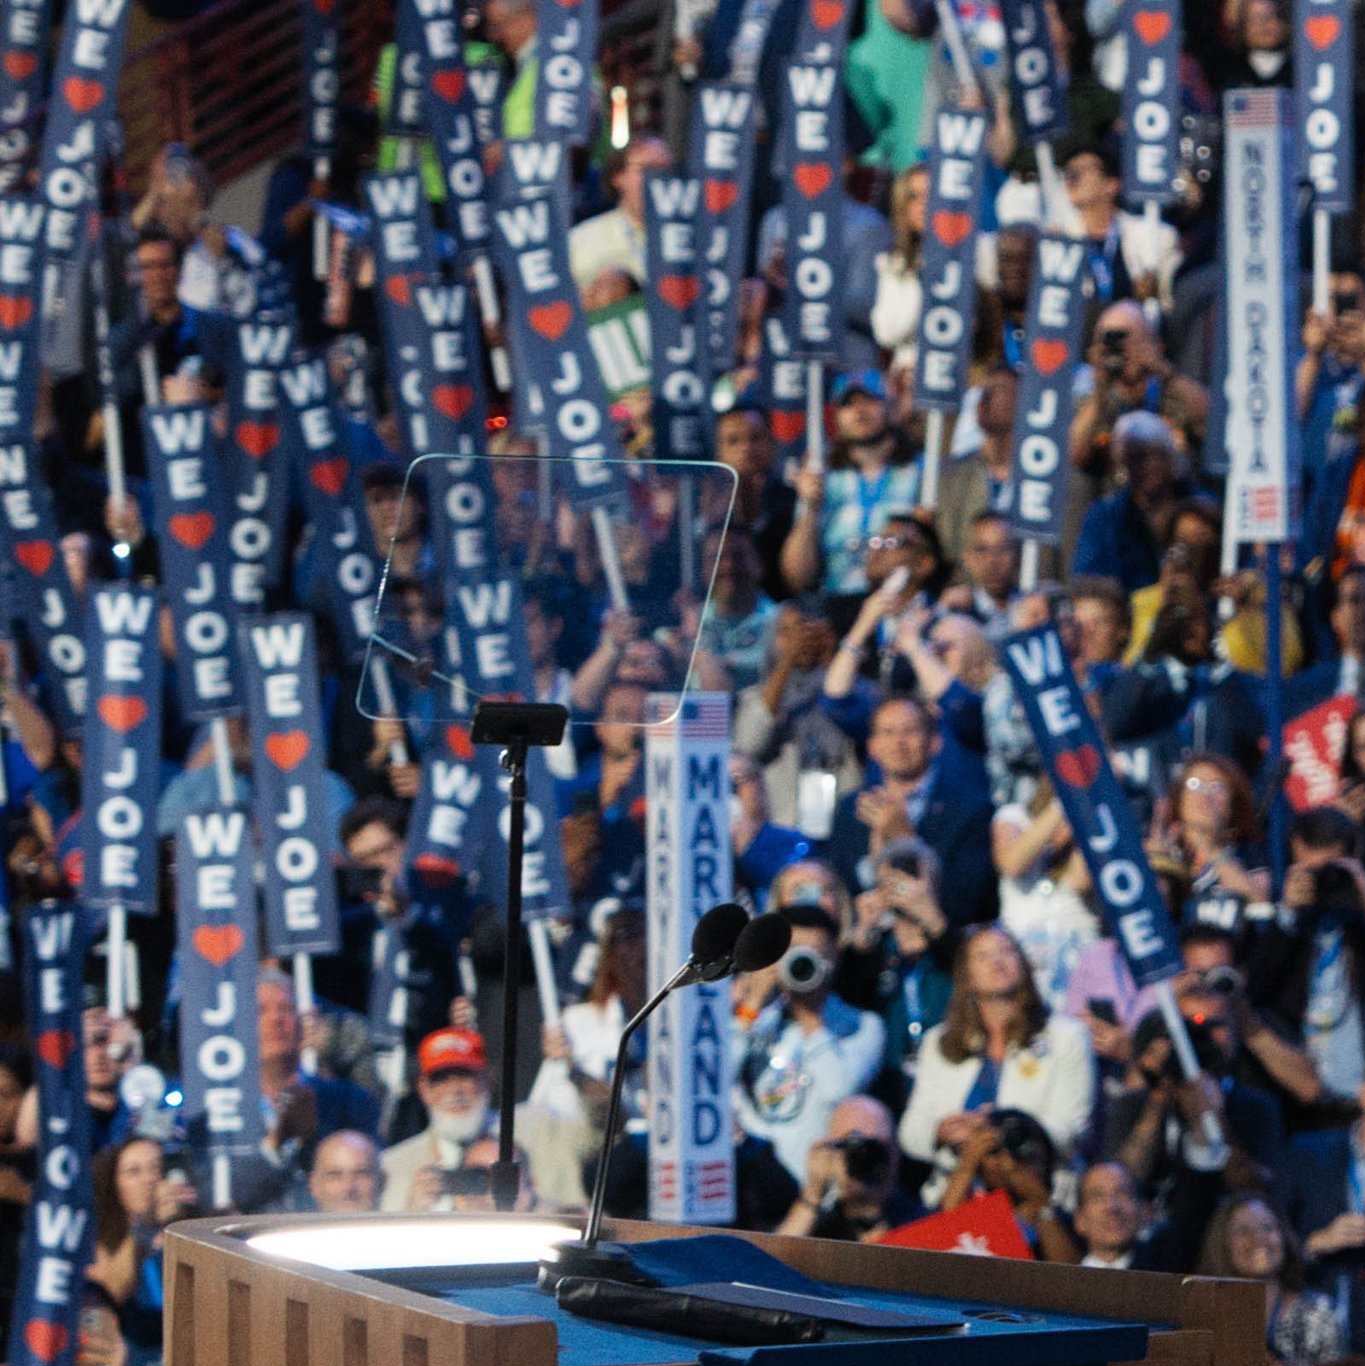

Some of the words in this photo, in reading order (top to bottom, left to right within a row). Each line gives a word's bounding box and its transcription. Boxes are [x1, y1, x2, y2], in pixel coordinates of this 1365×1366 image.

[9, 0, 41, 44] E
[544, 20, 585, 128] JOE
[1011, 2, 1054, 127] JOE
[699, 88, 754, 171] WE
[787, 65, 837, 152] WE
[936, 112, 986, 199] WE
[1132, 58, 1171, 184] JOE
[1306, 63, 1341, 193] JOE
[46, 120, 99, 250] JOE
[369, 178, 420, 262] WE
[446, 115, 489, 239] JOE
[651, 177, 702, 263] WE
[794, 211, 834, 343] JOE
[922, 261, 965, 393] JOE
[1037, 238, 1085, 329] WE
[239, 323, 291, 408] WE
[499, 202, 558, 294] WE
[552, 352, 613, 488] JOE
[661, 326, 703, 453] JOE
[416, 285, 468, 371] WE
[444, 433, 489, 567] JOE
[1019, 387, 1062, 522] JOE
[150, 412, 210, 499] WE
[185, 562, 232, 699] JOE
[229, 472, 273, 603] JOE
[280, 360, 335, 449] WE
[334, 508, 387, 638] JOE
[95, 591, 153, 682] WE
[251, 622, 304, 718] WE
[456, 580, 514, 679] WE
[98, 747, 144, 888] JOE
[276, 785, 320, 931] JOE
[427, 760, 482, 847] WE
[497, 775, 550, 898] OE
[1009, 633, 1083, 738] WE
[1088, 804, 1163, 960] JOE
[185, 812, 247, 909] WE
[29, 912, 76, 1014] WE
[688, 754, 723, 1150] MARAND
[198, 982, 249, 1133] JOE
[36, 1201, 87, 1303] WE
